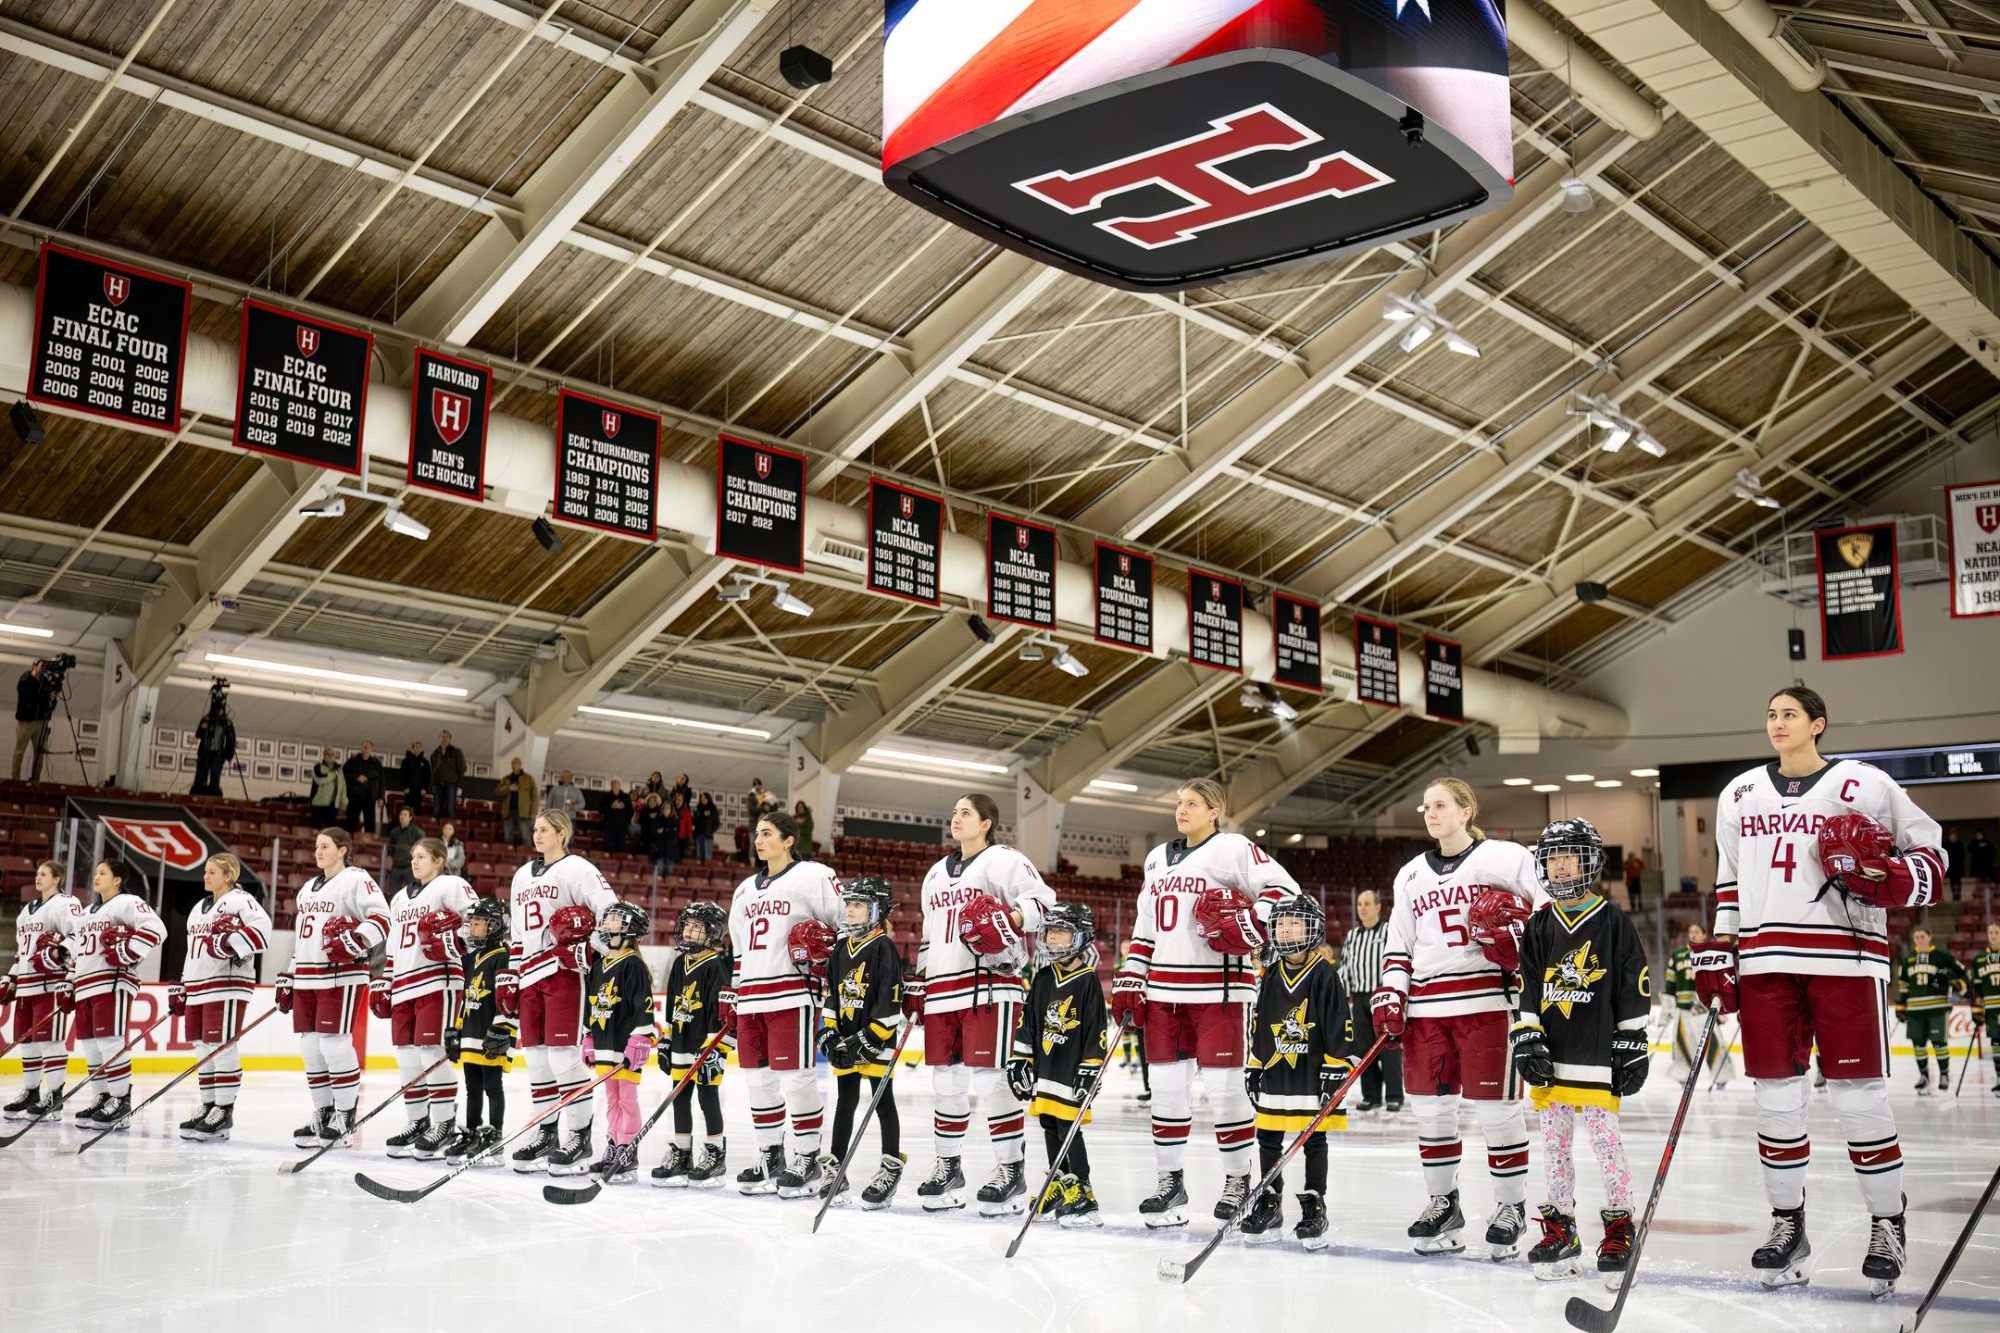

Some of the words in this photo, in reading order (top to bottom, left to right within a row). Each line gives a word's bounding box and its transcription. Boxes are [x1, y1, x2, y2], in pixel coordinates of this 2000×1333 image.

[1010, 102, 1396, 250] H
[109, 277, 124, 299] H
[87, 303, 140, 334] ECAC
[52, 316, 112, 350] FINAL
[115, 333, 168, 364] FOUR
[301, 330, 314, 350] H
[47, 341, 82, 361] 1998
[92, 353, 126, 373] 2001
[135, 364, 169, 384] 2002
[283, 355, 327, 383] ECAC
[45, 360, 80, 380] 2003
[90, 371, 124, 391] 2004
[133, 382, 168, 402] 2005
[427, 361, 480, 391] HARVARD
[43, 378, 78, 398] 2006
[88, 389, 123, 410] 2008
[132, 400, 166, 420] 2012
[252, 368, 304, 398] FINAL
[307, 382, 352, 410] FOUR
[250, 392, 280, 411] 2015
[287, 401, 316, 420] 2016
[324, 411, 353, 429] 2017
[440, 396, 461, 432] H
[248, 410, 278, 428] 2018
[285, 419, 315, 437] 2019
[322, 428, 352, 446] 2022
[605, 414, 616, 432] H
[247, 426, 277, 445] 2023
[432, 448, 465, 470] MEN'S
[568, 433, 590, 450] ECAC
[592, 440, 650, 466] TOURNAMENT
[417, 462, 435, 479] ICE
[436, 466, 476, 489] HOCKEY
[567, 449, 650, 484] CHAMPIONS
[759, 456, 768, 472] H
[565, 469, 590, 486] 1963
[596, 477, 620, 493] 1971
[625, 484, 649, 501] 1983
[727, 475, 746, 490] ECAC
[747, 481, 797, 503] TOURNAMENT
[565, 485, 590, 502] 1987
[595, 492, 619, 509] 1994
[625, 500, 649, 516] 2002
[726, 490, 797, 521] CHAMPIONS
[903, 498, 911, 513] H
[563, 501, 589, 518] 2004
[594, 508, 618, 524] 2006
[624, 515, 648, 530] 2015
[726, 509, 747, 525] 2017
[752, 515, 773, 530] 2022
[1982, 507, 1997, 527] H
[892, 517, 920, 538] NCAA
[875, 529, 935, 557] TOURNAMENT
[1009, 548, 1036, 567] NCAA
[994, 560, 1050, 584] TOURNAMENT
[1113, 574, 1136, 593] NCAA
[1960, 570, 2000, 585] CHAMP
[1100, 586, 1148, 609] TOURNAMENT
[1205, 600, 1227, 617] NCAA
[115, 663, 123, 683] 5
[504, 717, 512, 733] 4
[797, 756, 805, 771] 3
[1024, 787, 1031, 800] 2
[1786, 781, 1801, 794] H
[1839, 778, 1860, 803] C
[1740, 813, 1827, 838] HARVAR
[127, 825, 192, 857] H
[1248, 842, 1271, 866] 10
[1770, 836, 1797, 883] 4
[1834, 859, 1842, 871] 4
[1150, 876, 1208, 897] ARVARD
[1222, 889, 1233, 900] H
[297, 901, 335, 915] ARVARD
[744, 900, 791, 918] ARVARD
[929, 887, 984, 911] HARVARD
[1514, 895, 1525, 908] H
[524, 901, 544, 931] 13
[573, 917, 581, 928] H
[1155, 894, 1179, 932] 10
[298, 914, 316, 940] 16
[400, 921, 417, 949] 15
[748, 917, 769, 951] 12
[945, 907, 957, 944] 11
[1438, 907, 1469, 948] 5
[1471, 926, 1477, 937] 5
[190, 935, 208, 960] 17
[1691, 955, 1728, 967] UER
[1112, 979, 1143, 989] AUER
[1638, 965, 1651, 997] 6
[892, 983, 900, 1003] 1
[1543, 982, 1595, 1004] WIZARDS
[644, 996, 654, 1014] 2
[1042, 1031, 1069, 1045] ZARDS
[1344, 1019, 1354, 1042] 5
[1511, 1031, 1541, 1051] UER
[1611, 1040, 1648, 1051] BAUE
[1078, 1068, 1100, 1076] CC
[619, 1118, 655, 1167] BAUER
